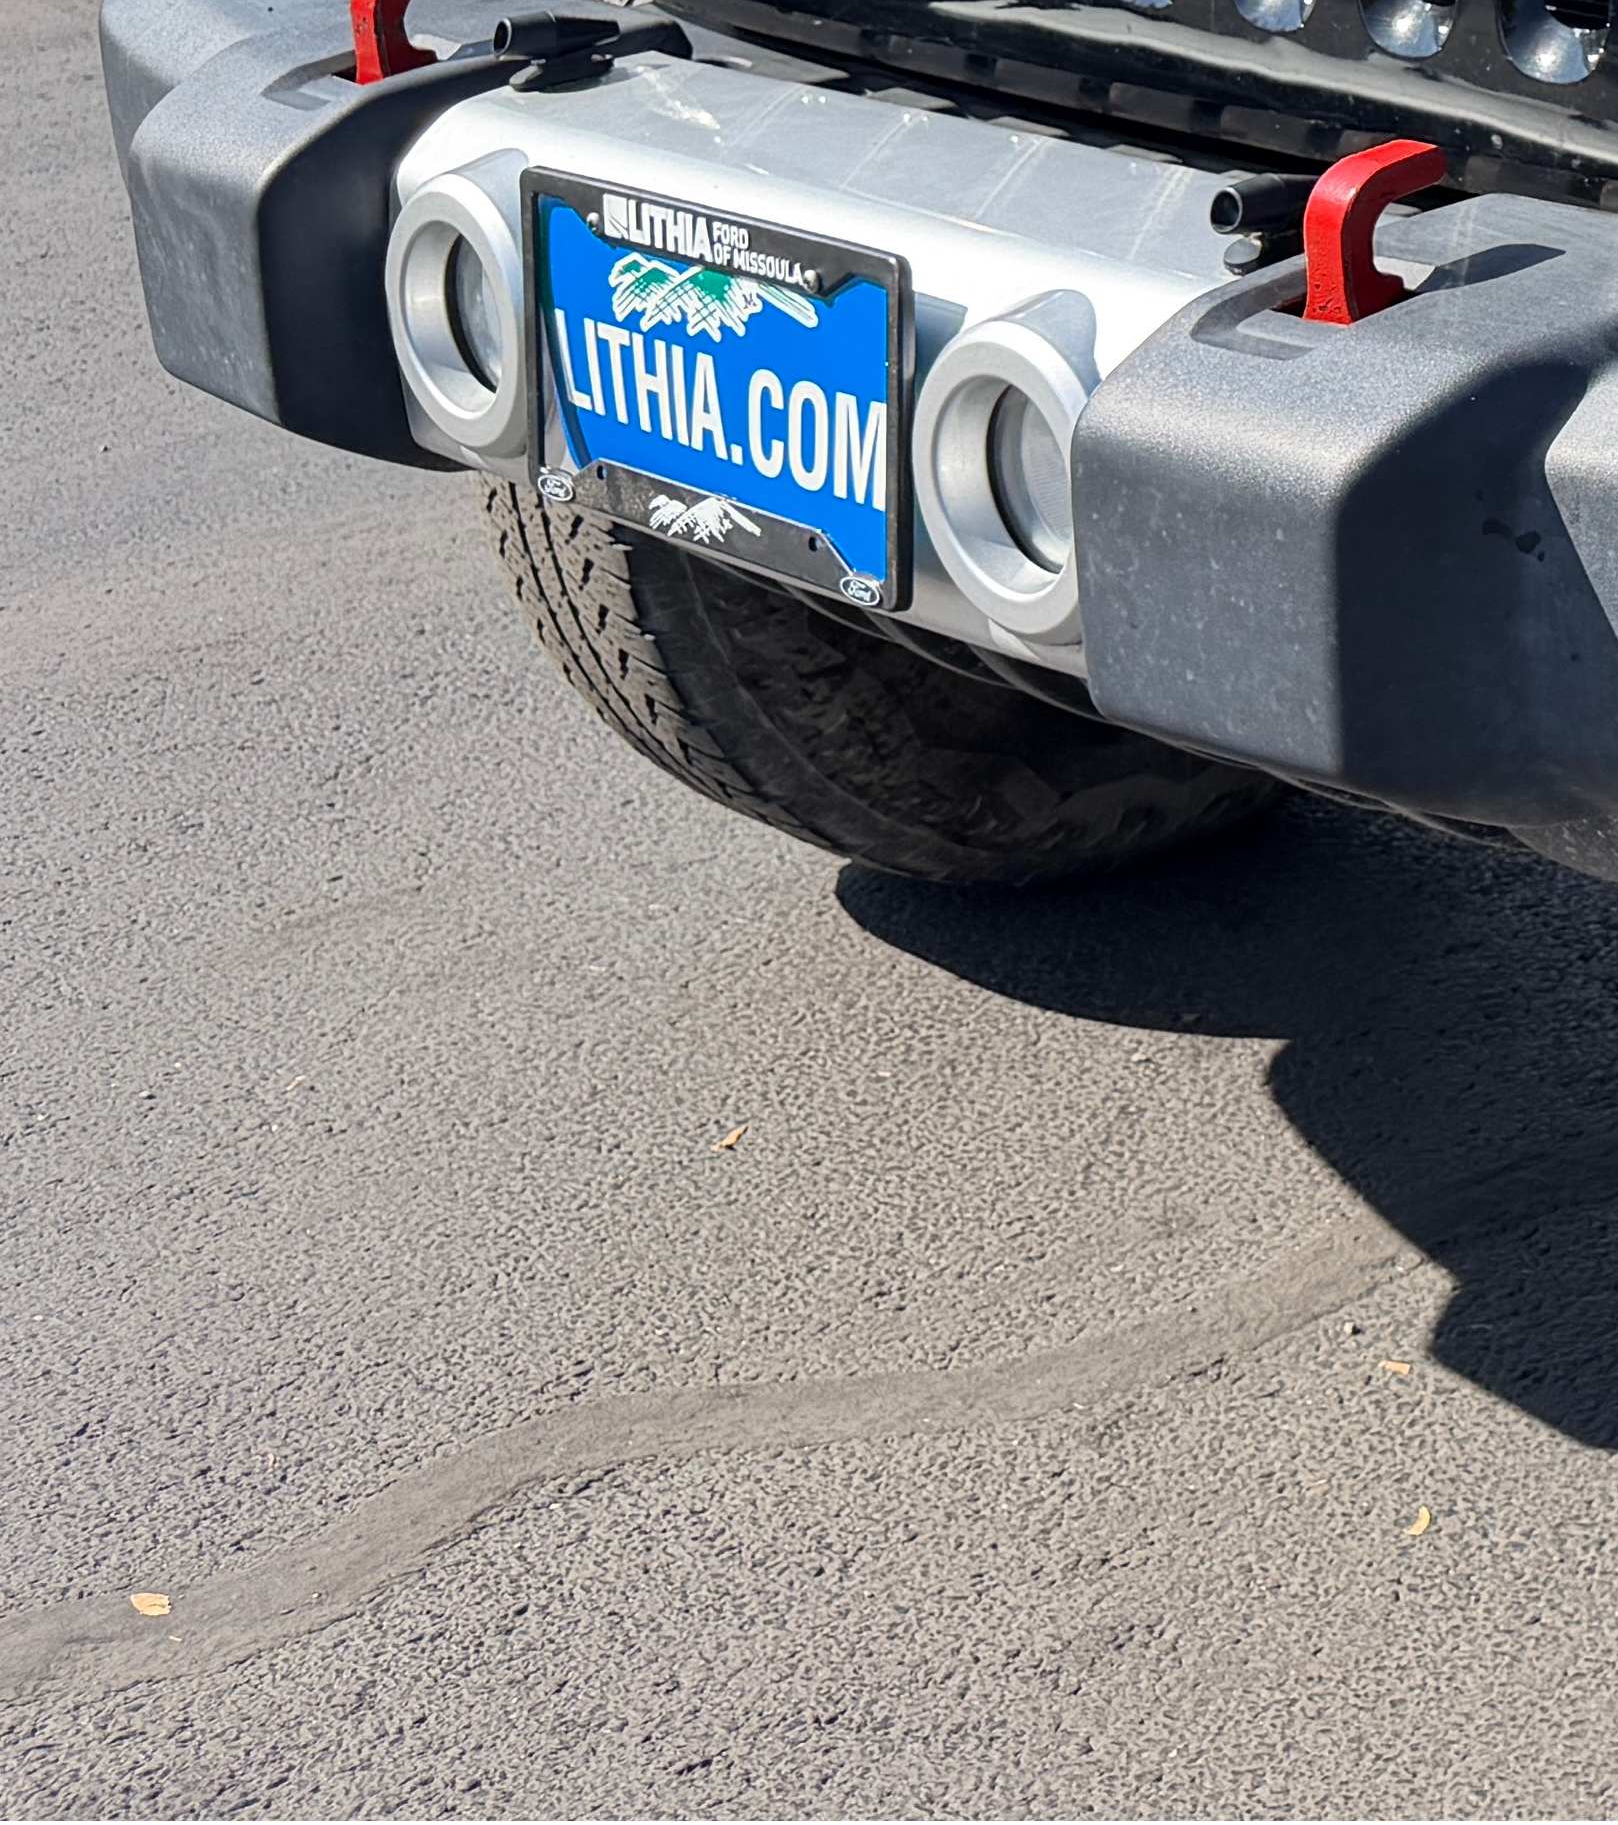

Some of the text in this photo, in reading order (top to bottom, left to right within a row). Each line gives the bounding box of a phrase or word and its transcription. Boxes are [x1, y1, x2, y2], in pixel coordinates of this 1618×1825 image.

[628, 199, 714, 263] LITHIA
[712, 221, 749, 249] FORD
[713, 243, 804, 286] OF MISSOULA
[555, 308, 887, 512] LITHIA.COM
[847, 579, 872, 602] Ford
